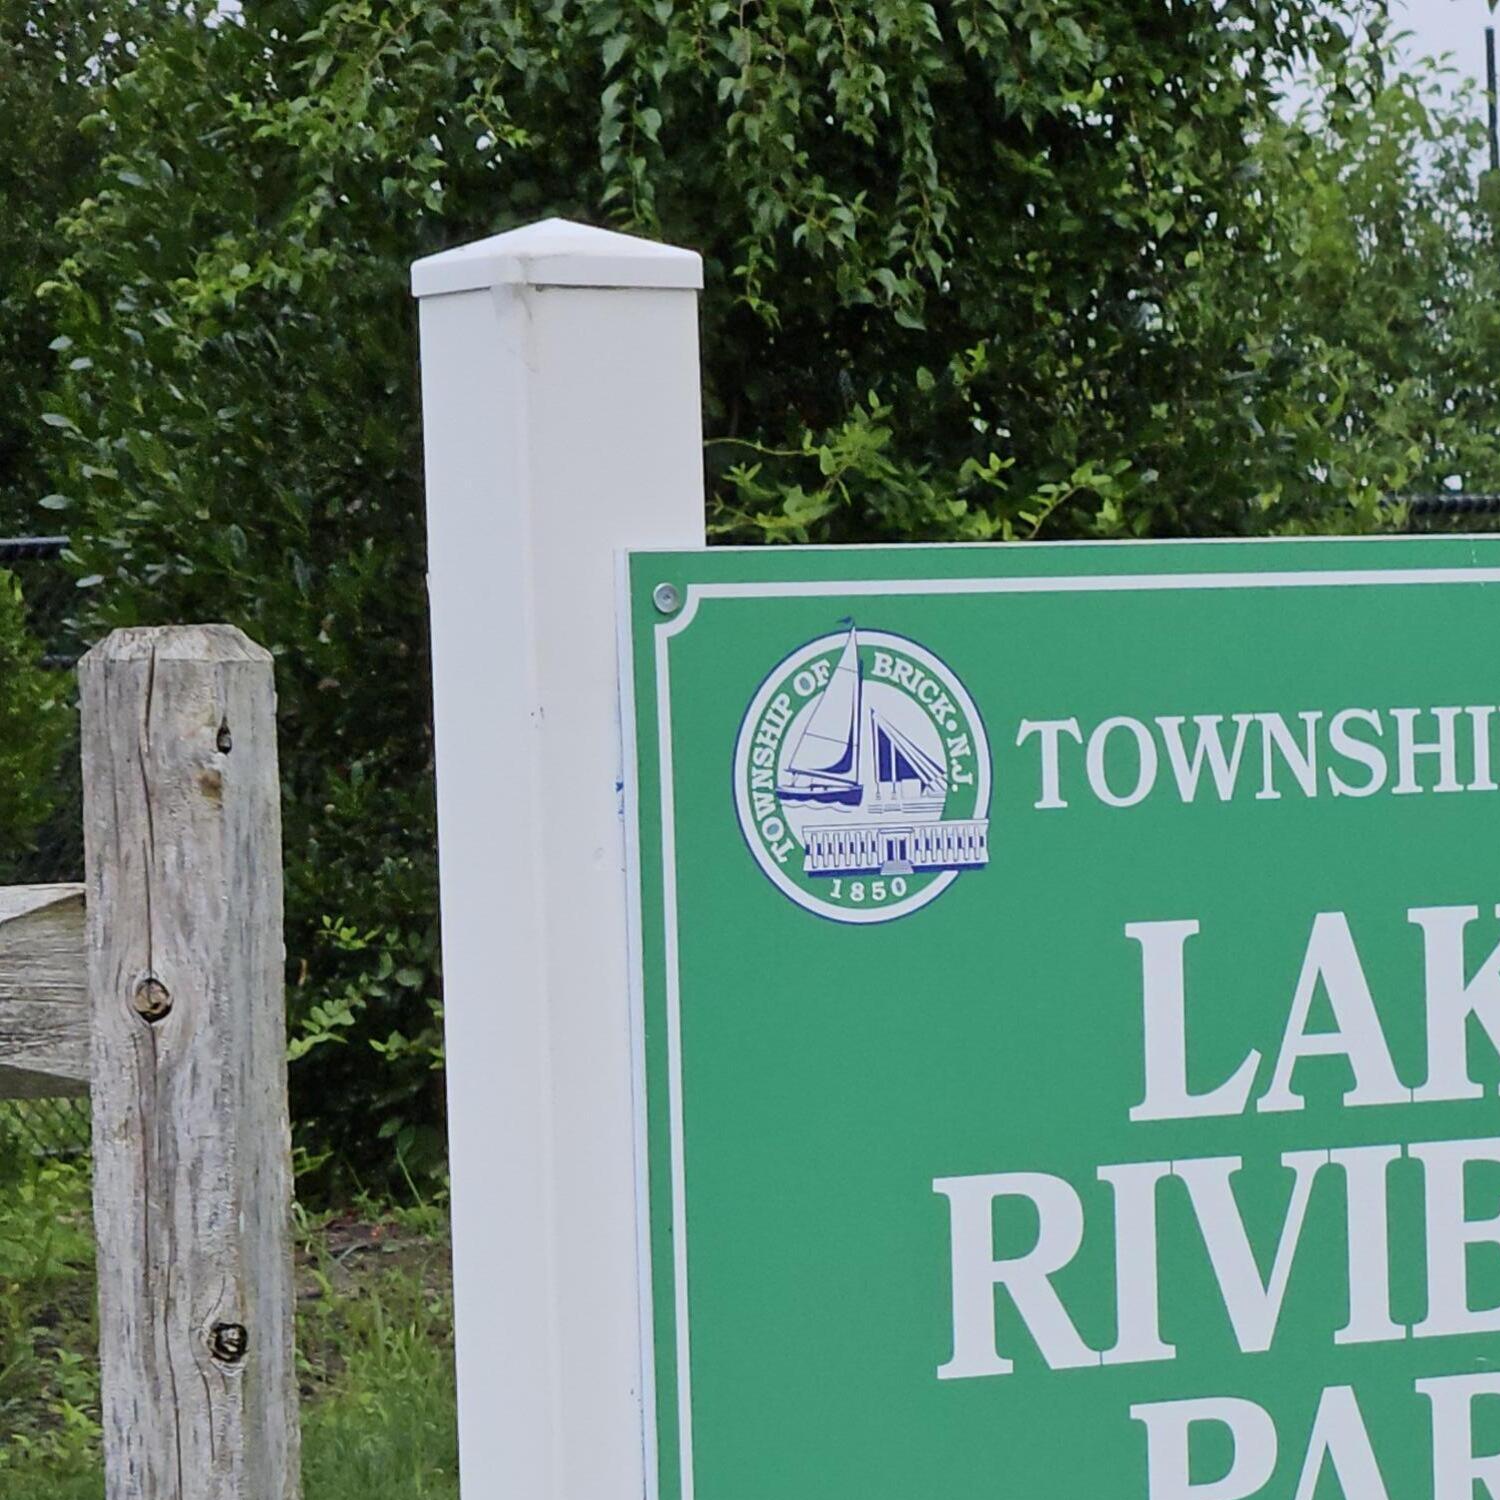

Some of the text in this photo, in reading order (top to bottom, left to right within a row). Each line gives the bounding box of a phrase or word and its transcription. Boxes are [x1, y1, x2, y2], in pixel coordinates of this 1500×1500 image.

[751, 694, 795, 863] TOWNSHIP
[793, 658, 831, 697] OF
[870, 651, 958, 727] BRICK
[829, 876, 907, 902] 1850
